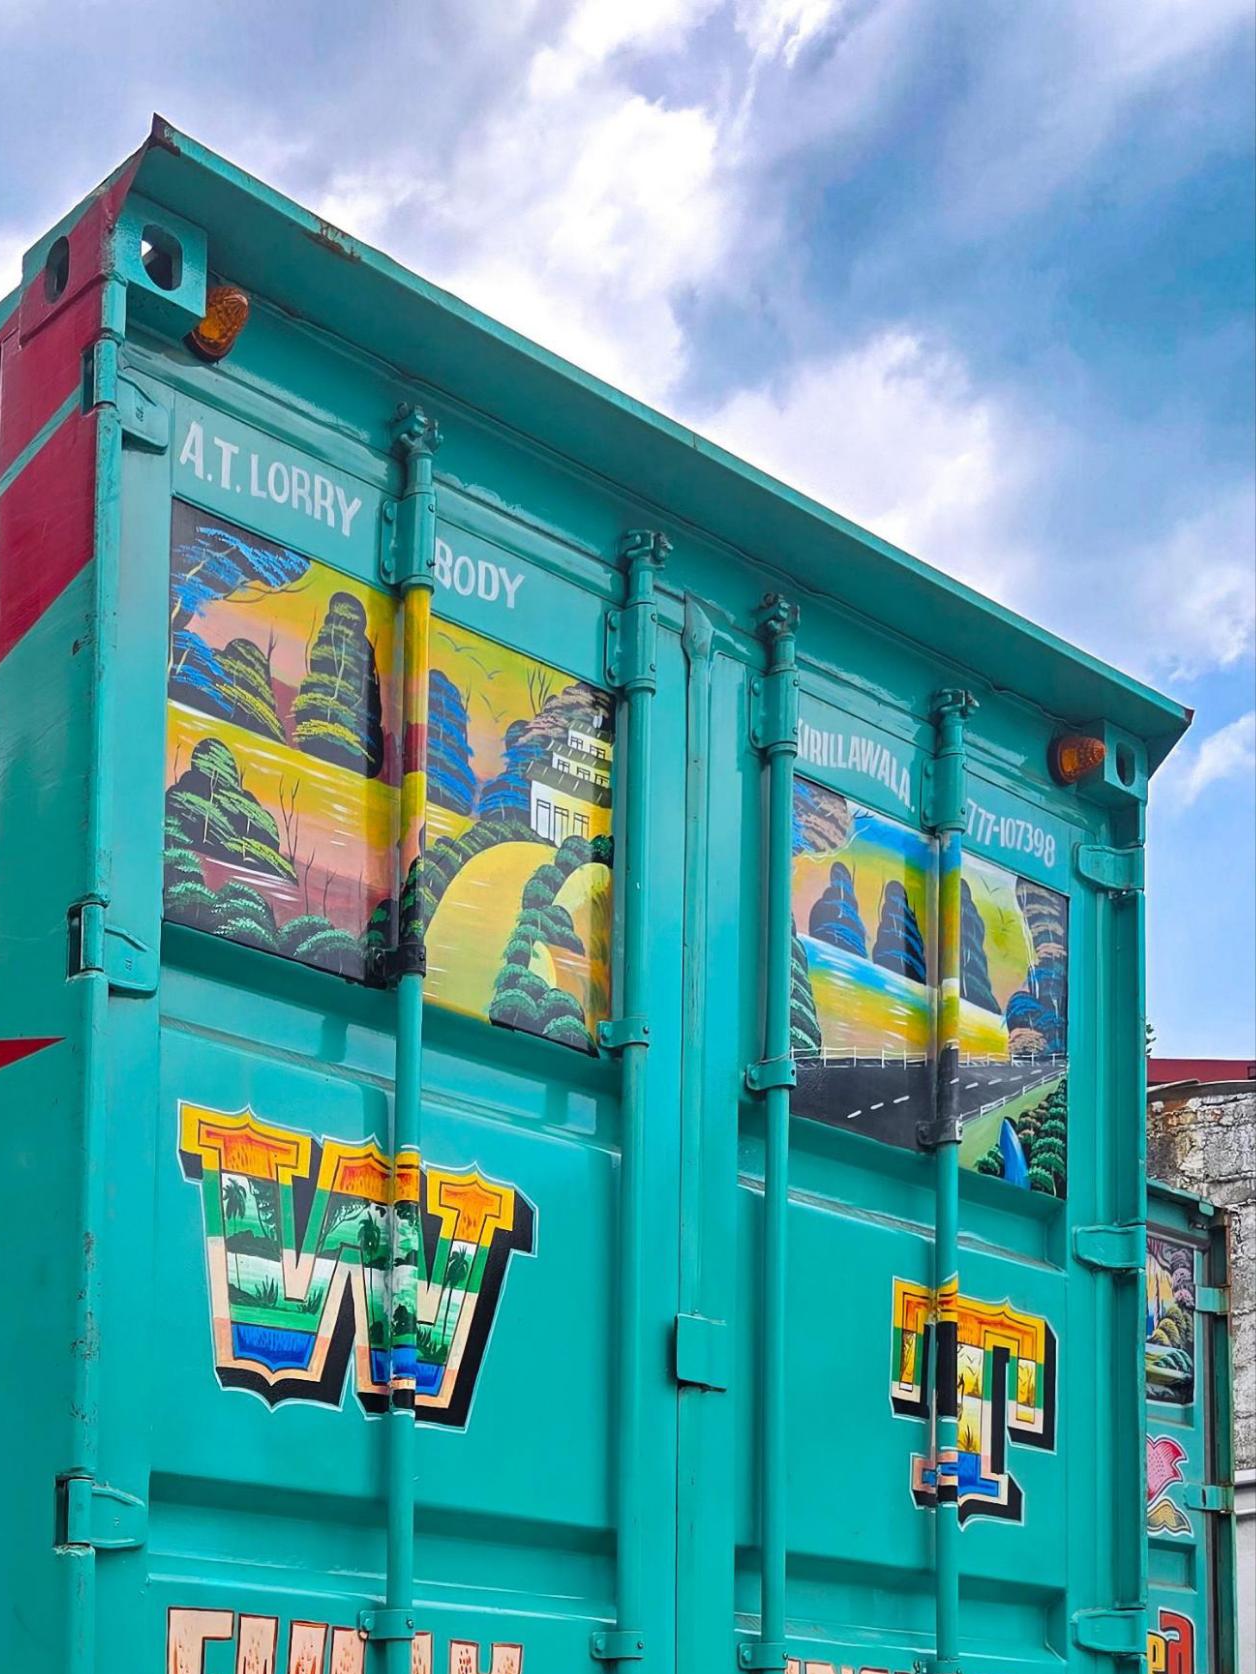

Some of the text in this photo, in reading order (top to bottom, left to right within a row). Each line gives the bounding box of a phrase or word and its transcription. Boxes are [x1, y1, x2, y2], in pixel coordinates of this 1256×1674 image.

[179, 420, 526, 609] A.T. LORRY BODY
[891, 1271, 1058, 1531] T
